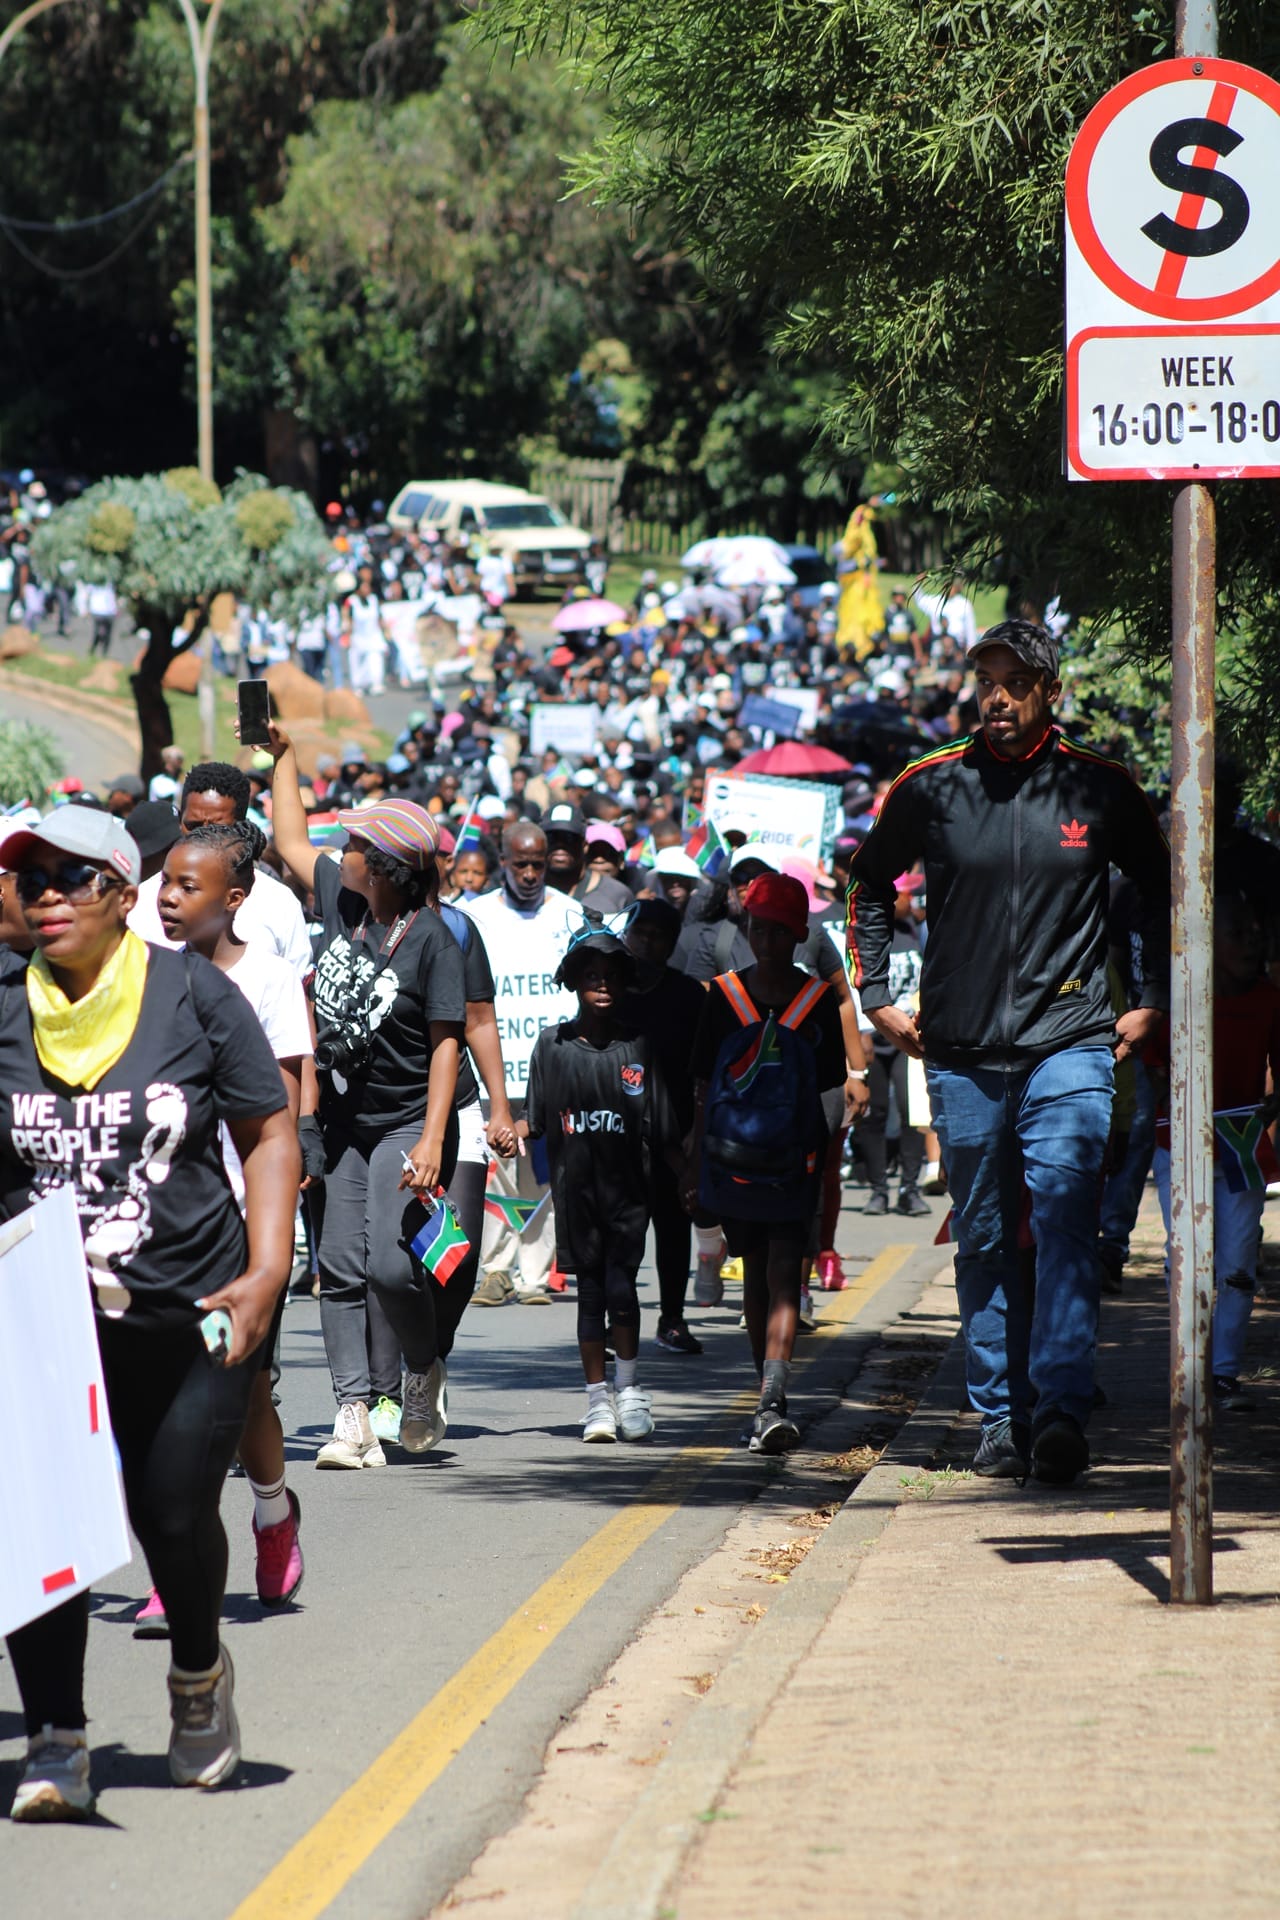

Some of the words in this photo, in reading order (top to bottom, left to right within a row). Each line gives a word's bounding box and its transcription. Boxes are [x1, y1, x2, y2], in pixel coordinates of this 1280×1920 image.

[1140, 117, 1250, 257] S
[1161, 356, 1235, 387] WEEK
[1092, 400, 1280, 446] 16:00-18:0
[1060, 839, 1088, 848] adidas
[386, 919, 407, 947] Canon
[71, 1091, 131, 1129] THE
[11, 1126, 120, 1163] PEOPLE
